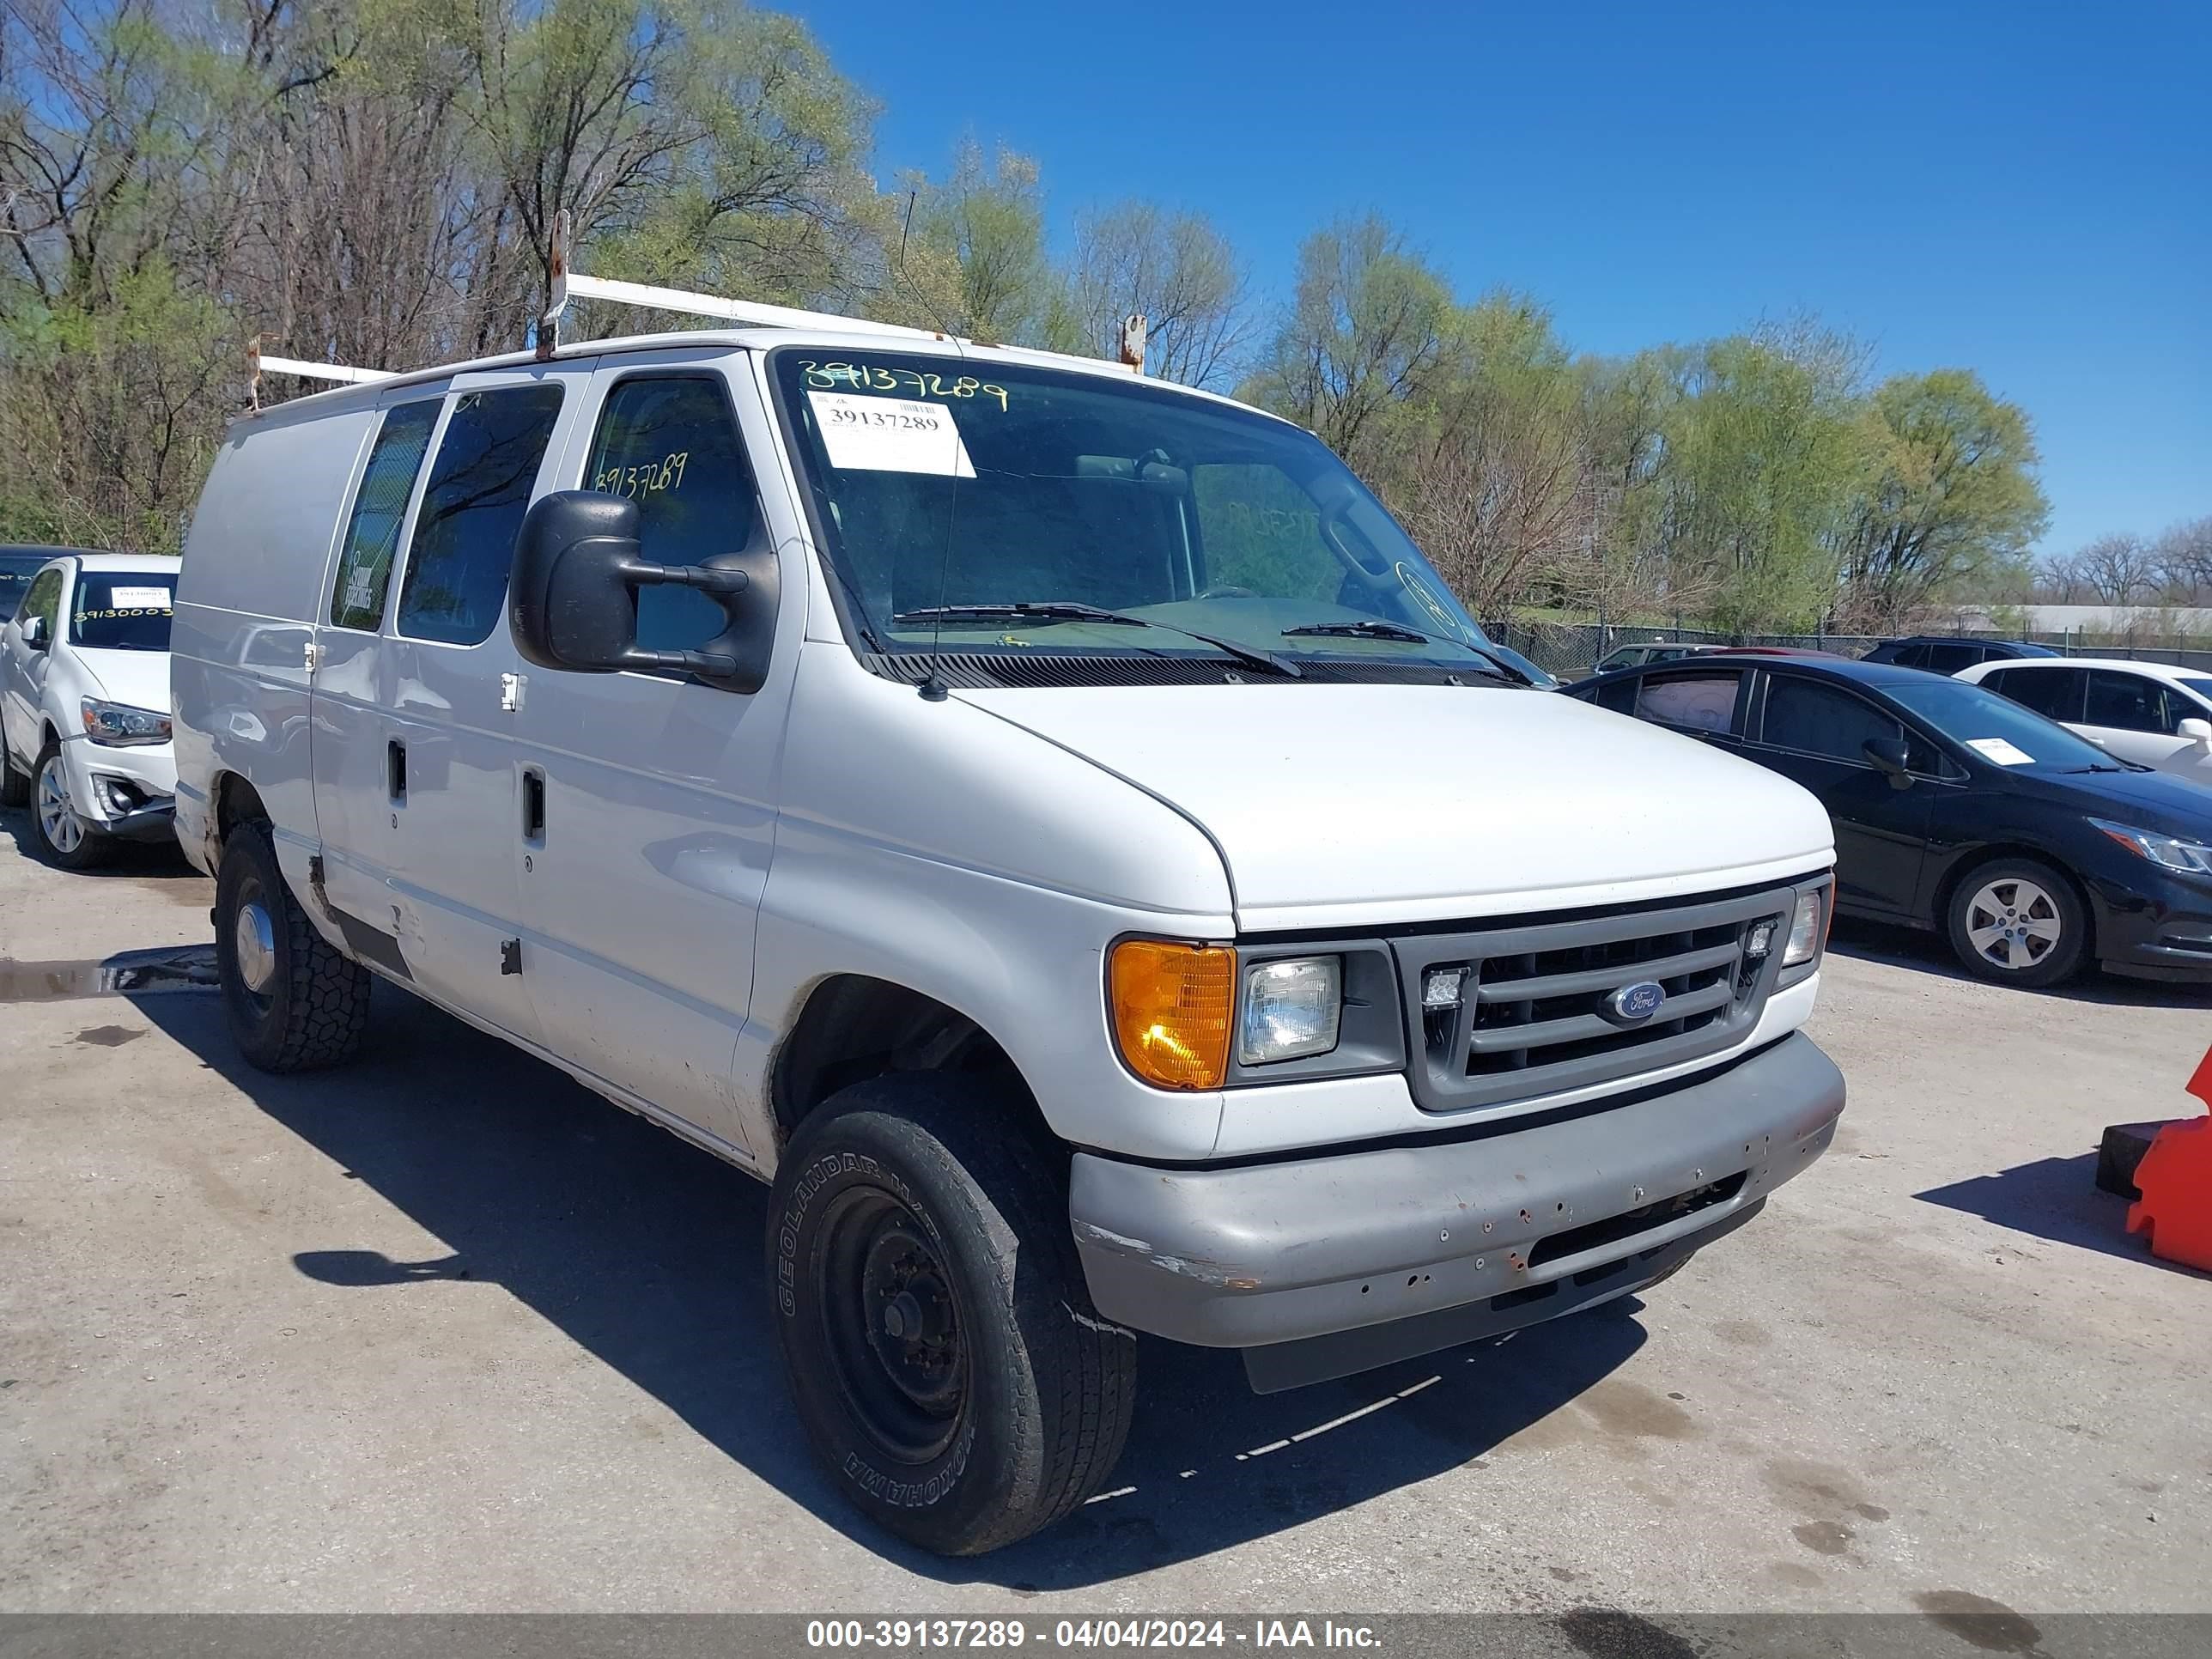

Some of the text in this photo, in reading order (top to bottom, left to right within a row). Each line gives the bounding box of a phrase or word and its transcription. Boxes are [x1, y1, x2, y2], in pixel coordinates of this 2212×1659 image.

[798, 361, 1008, 412] 39137289
[830, 409, 939, 430] 39137289
[1631, 991, 1656, 1011] Ford
[779, 1152, 881, 1317] GEOLANDAR
[843, 1420, 975, 1507] YOKOHAMA
